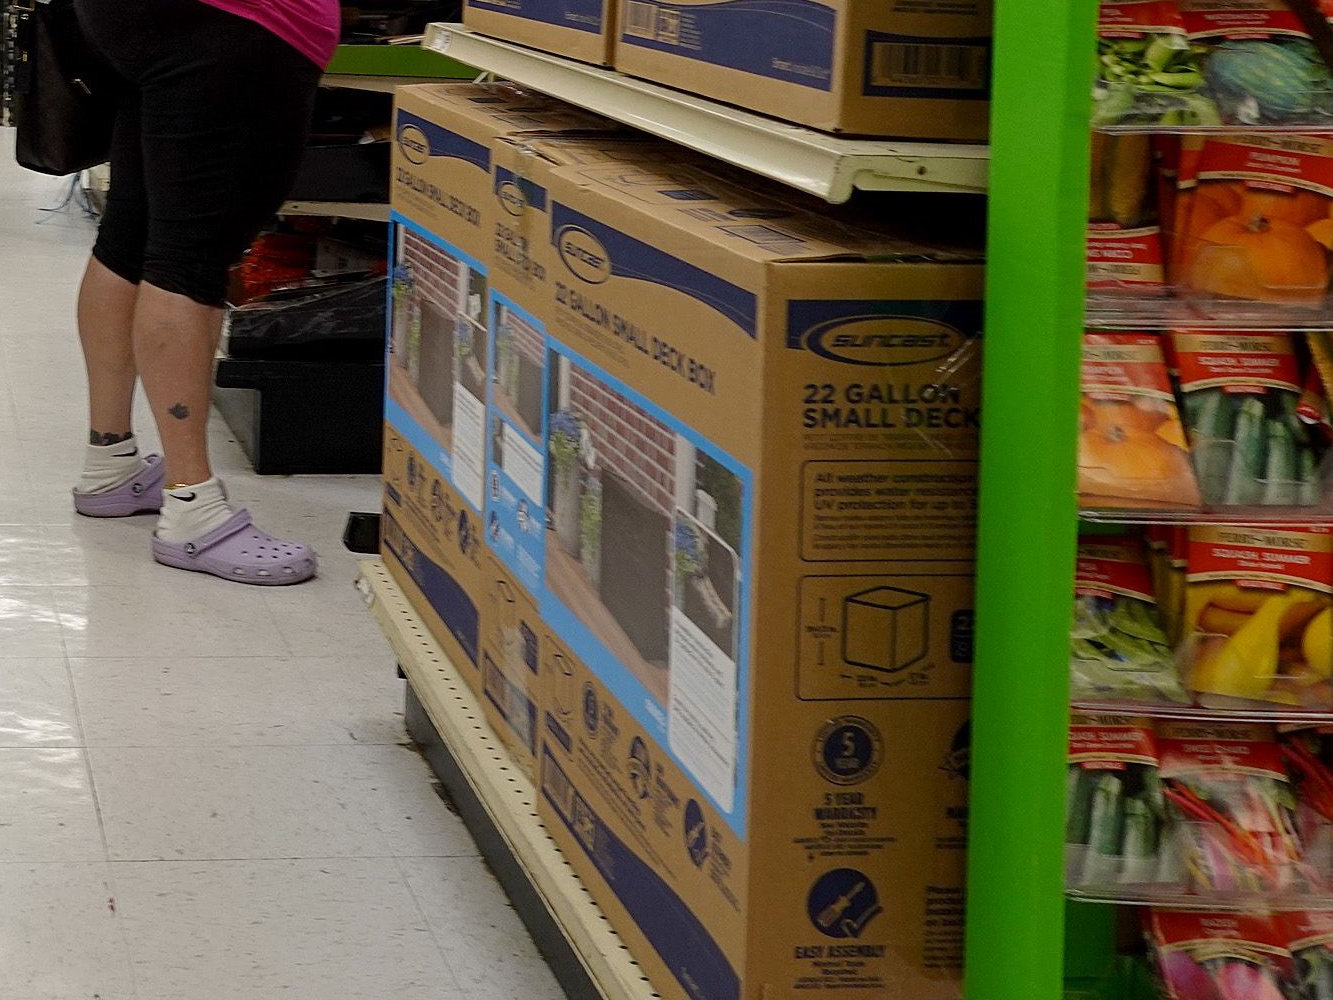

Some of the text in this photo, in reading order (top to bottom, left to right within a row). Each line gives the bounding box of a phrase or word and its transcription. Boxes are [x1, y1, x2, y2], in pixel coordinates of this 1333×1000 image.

[832, 333, 952, 347] suncast
[651, 335, 687, 378] DECK
[688, 357, 716, 397] BOX
[803, 383, 961, 405] 22 GALLON
[802, 406, 981, 429] SMALL DECK
[1262, 552, 1312, 565] SUMMER
[843, 731, 857, 757] 5
